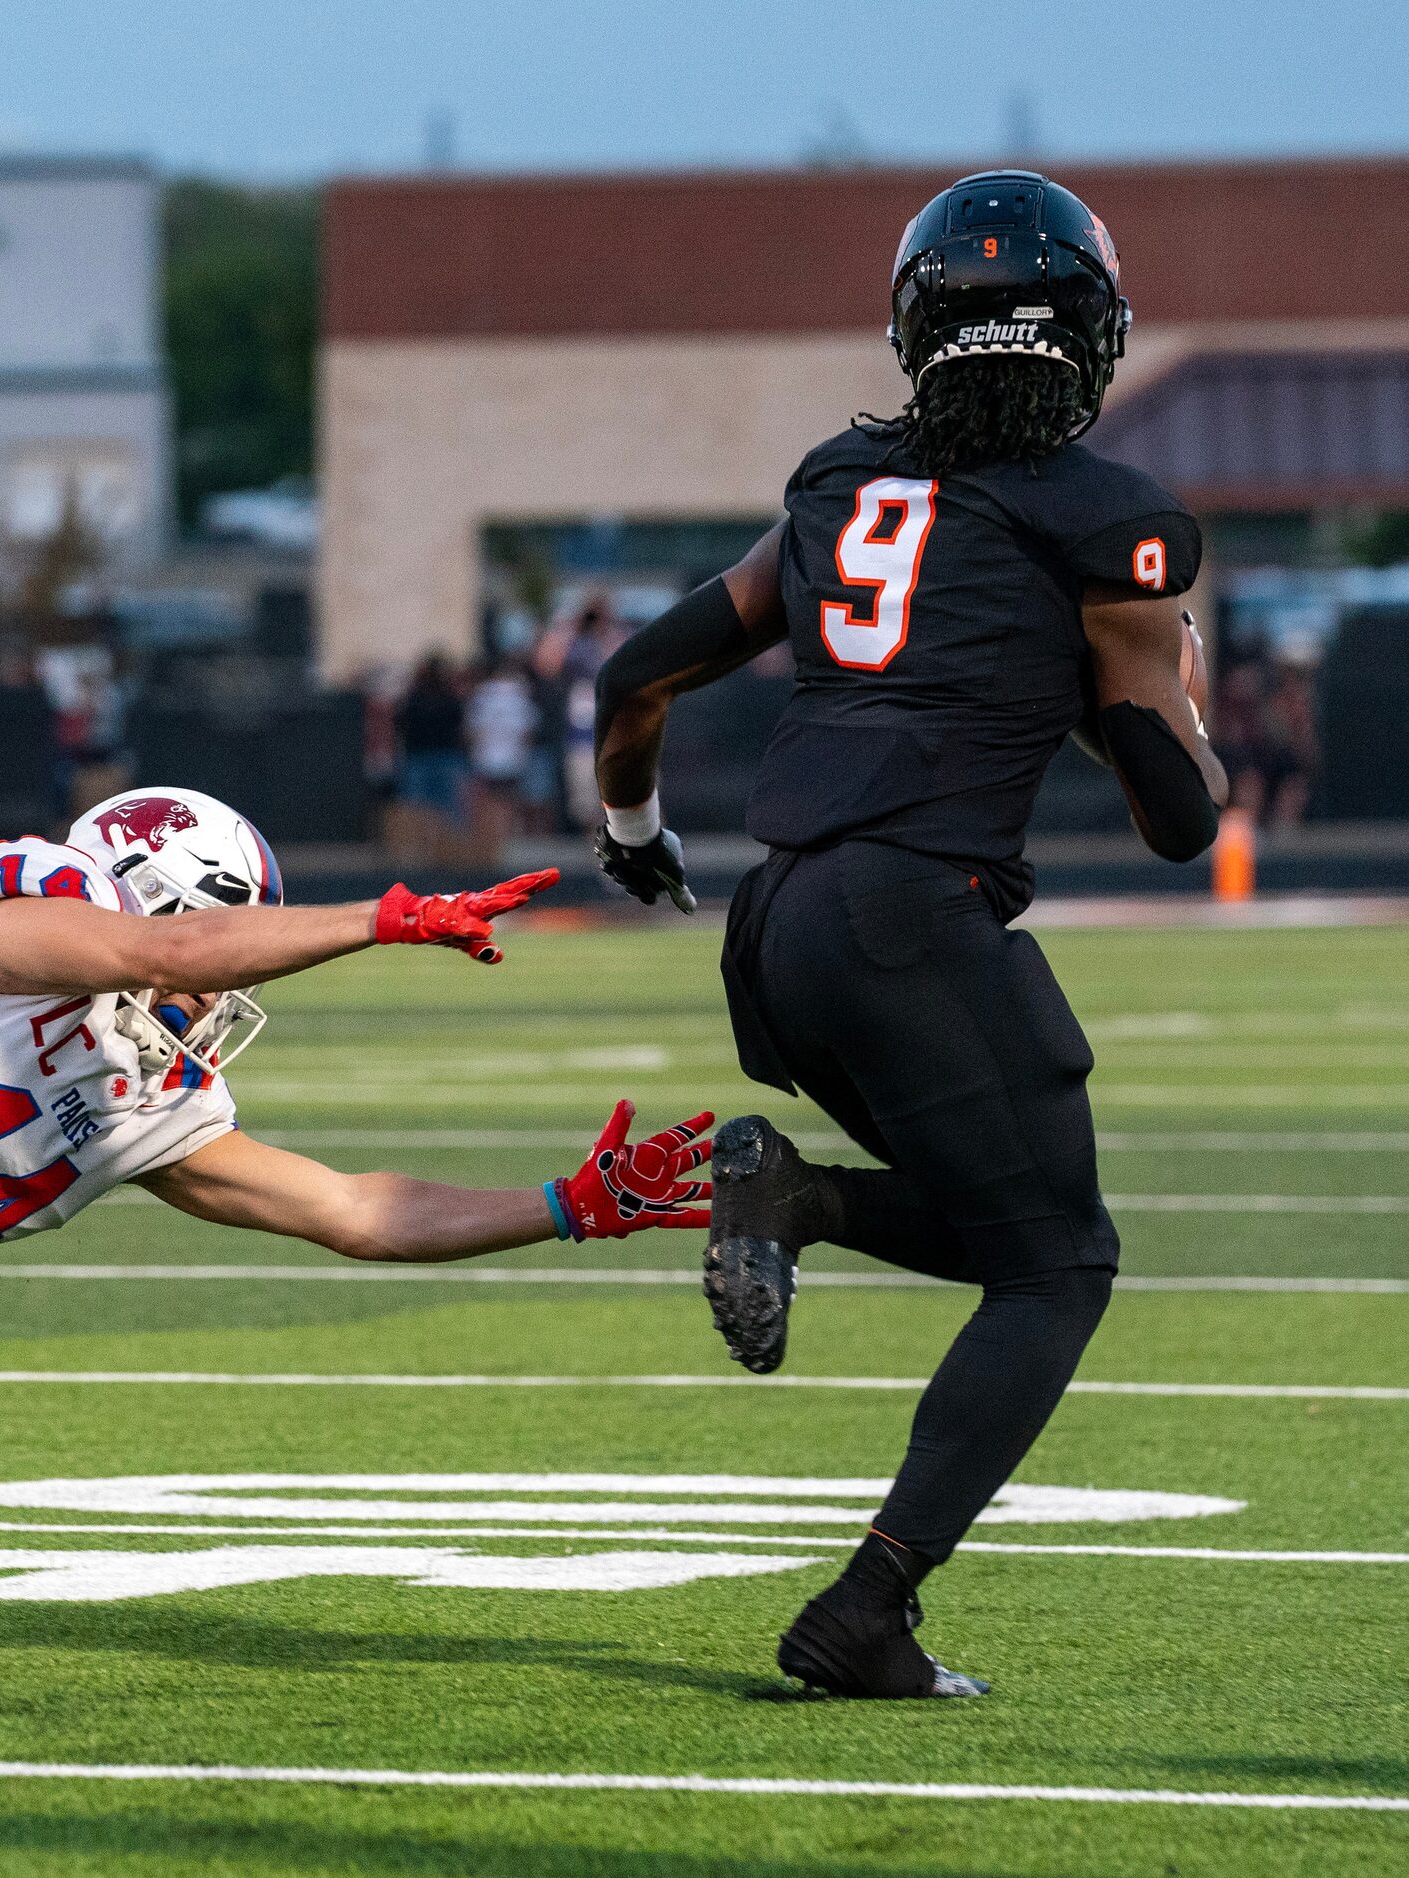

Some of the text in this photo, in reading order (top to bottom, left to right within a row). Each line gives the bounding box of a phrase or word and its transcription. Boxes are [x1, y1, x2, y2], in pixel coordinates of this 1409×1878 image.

[984, 238, 998, 258] 9
[1014, 308, 1052, 317] GUILLORY
[958, 320, 1038, 344] schutt
[820, 476, 939, 673] 9
[1132, 537, 1167, 591] 9
